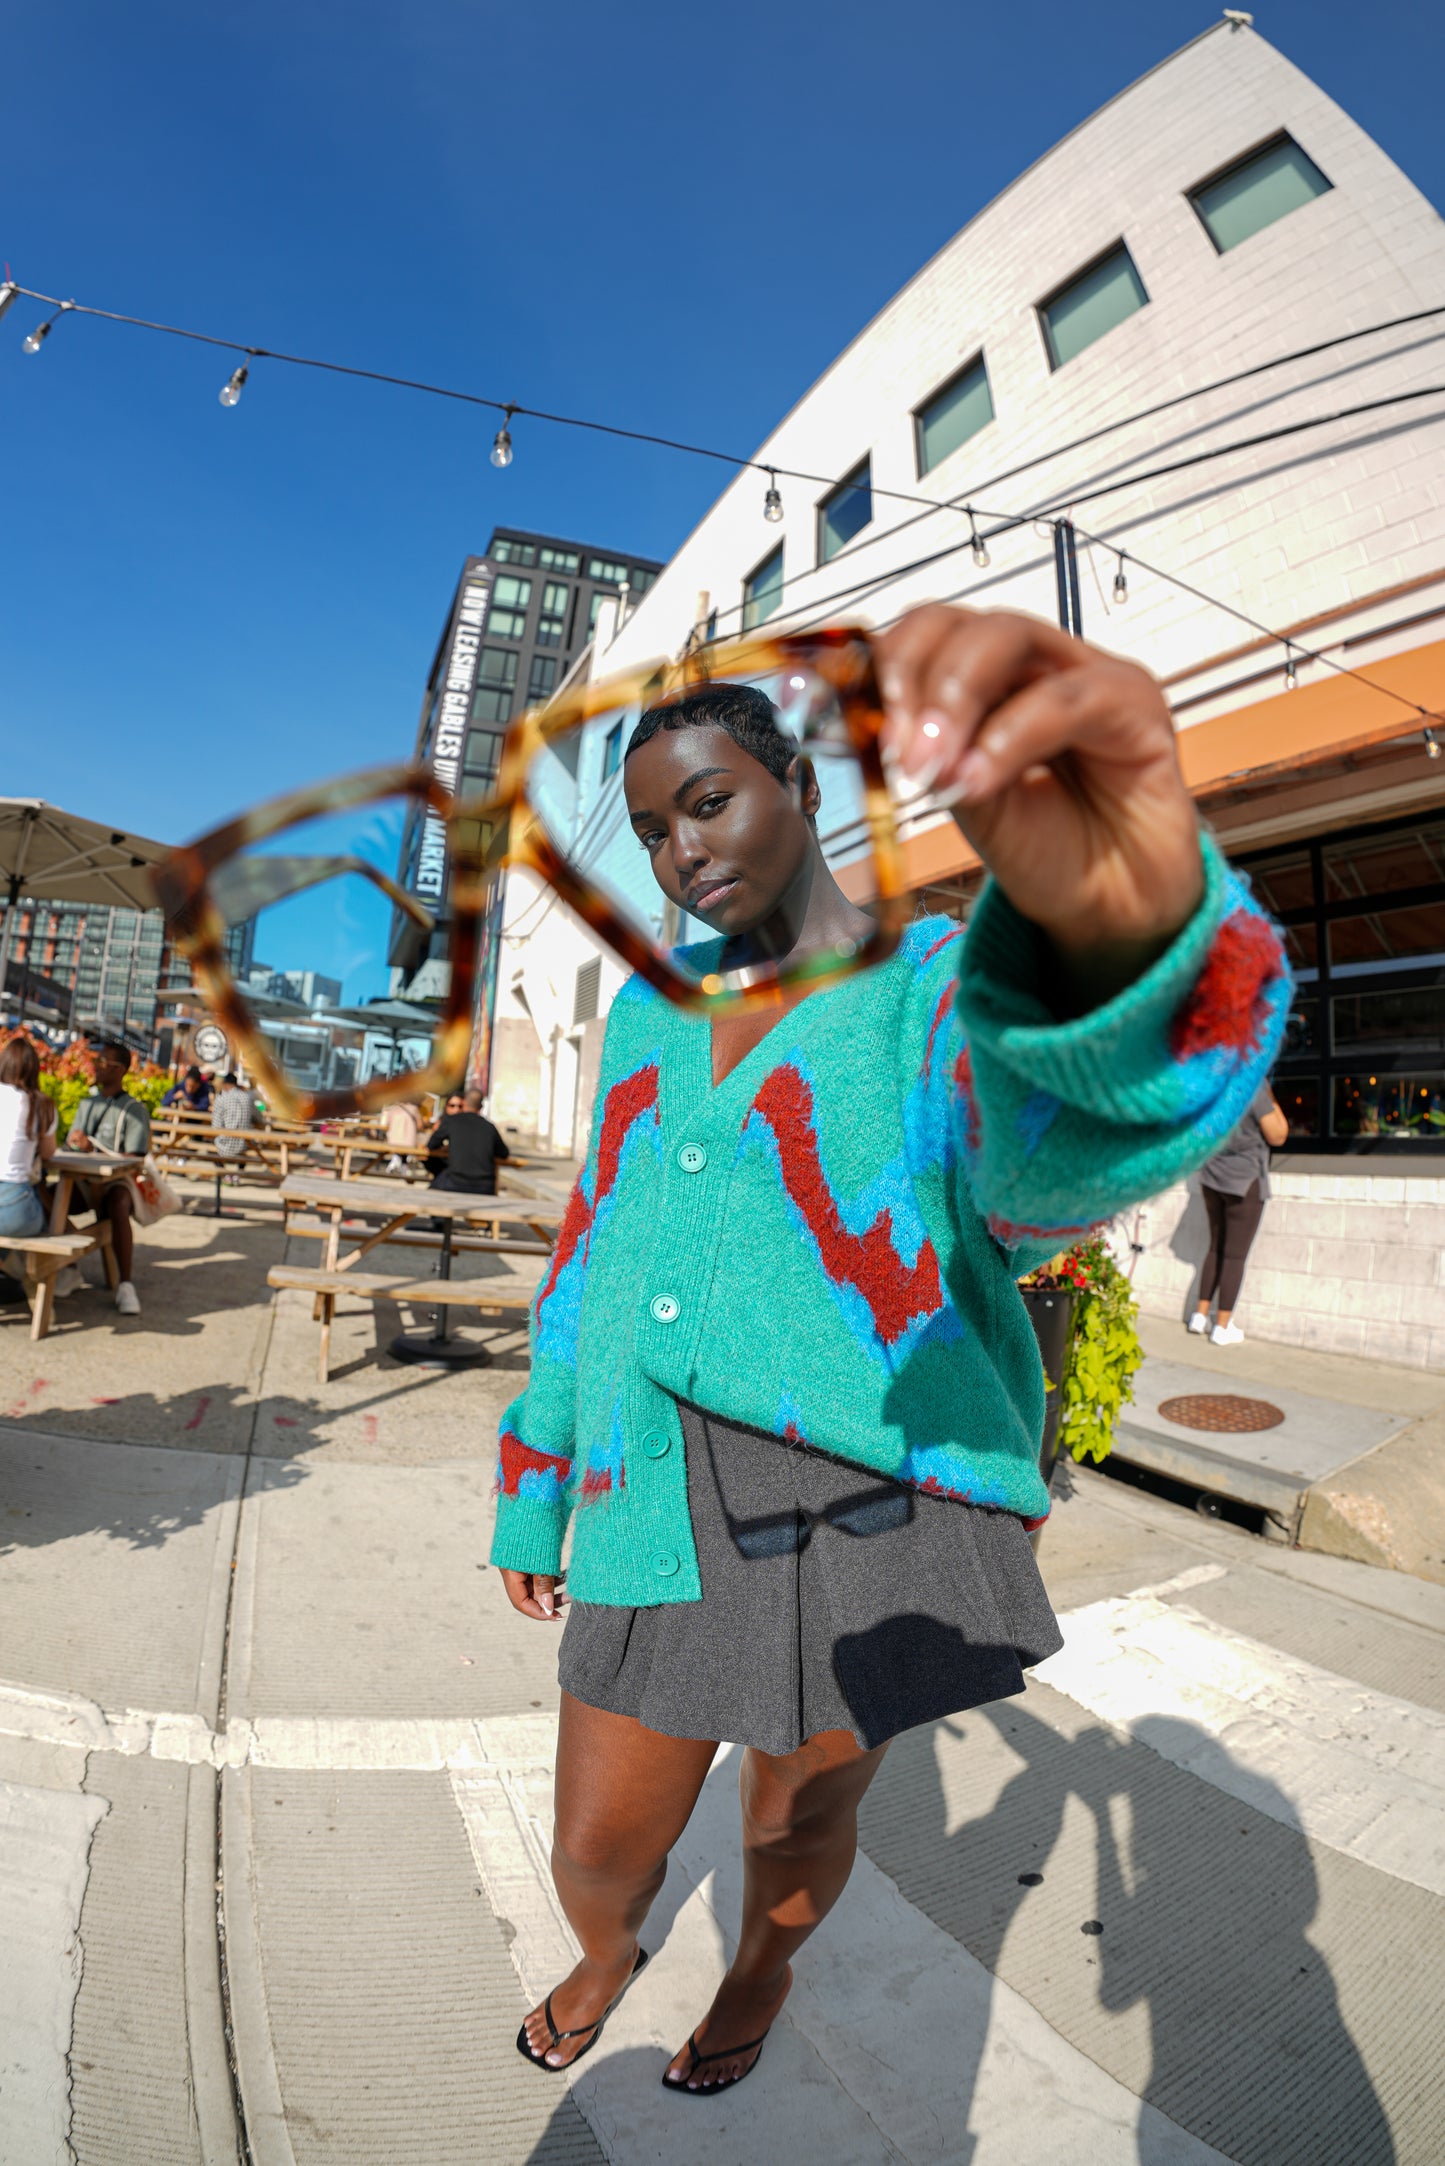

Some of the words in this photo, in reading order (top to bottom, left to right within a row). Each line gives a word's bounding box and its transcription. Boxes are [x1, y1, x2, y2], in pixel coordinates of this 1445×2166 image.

[459, 585, 489, 627] NOW
[446, 624, 482, 692] LEASING
[435, 691, 469, 758] GABLES
[416, 817, 447, 896] MARKET
